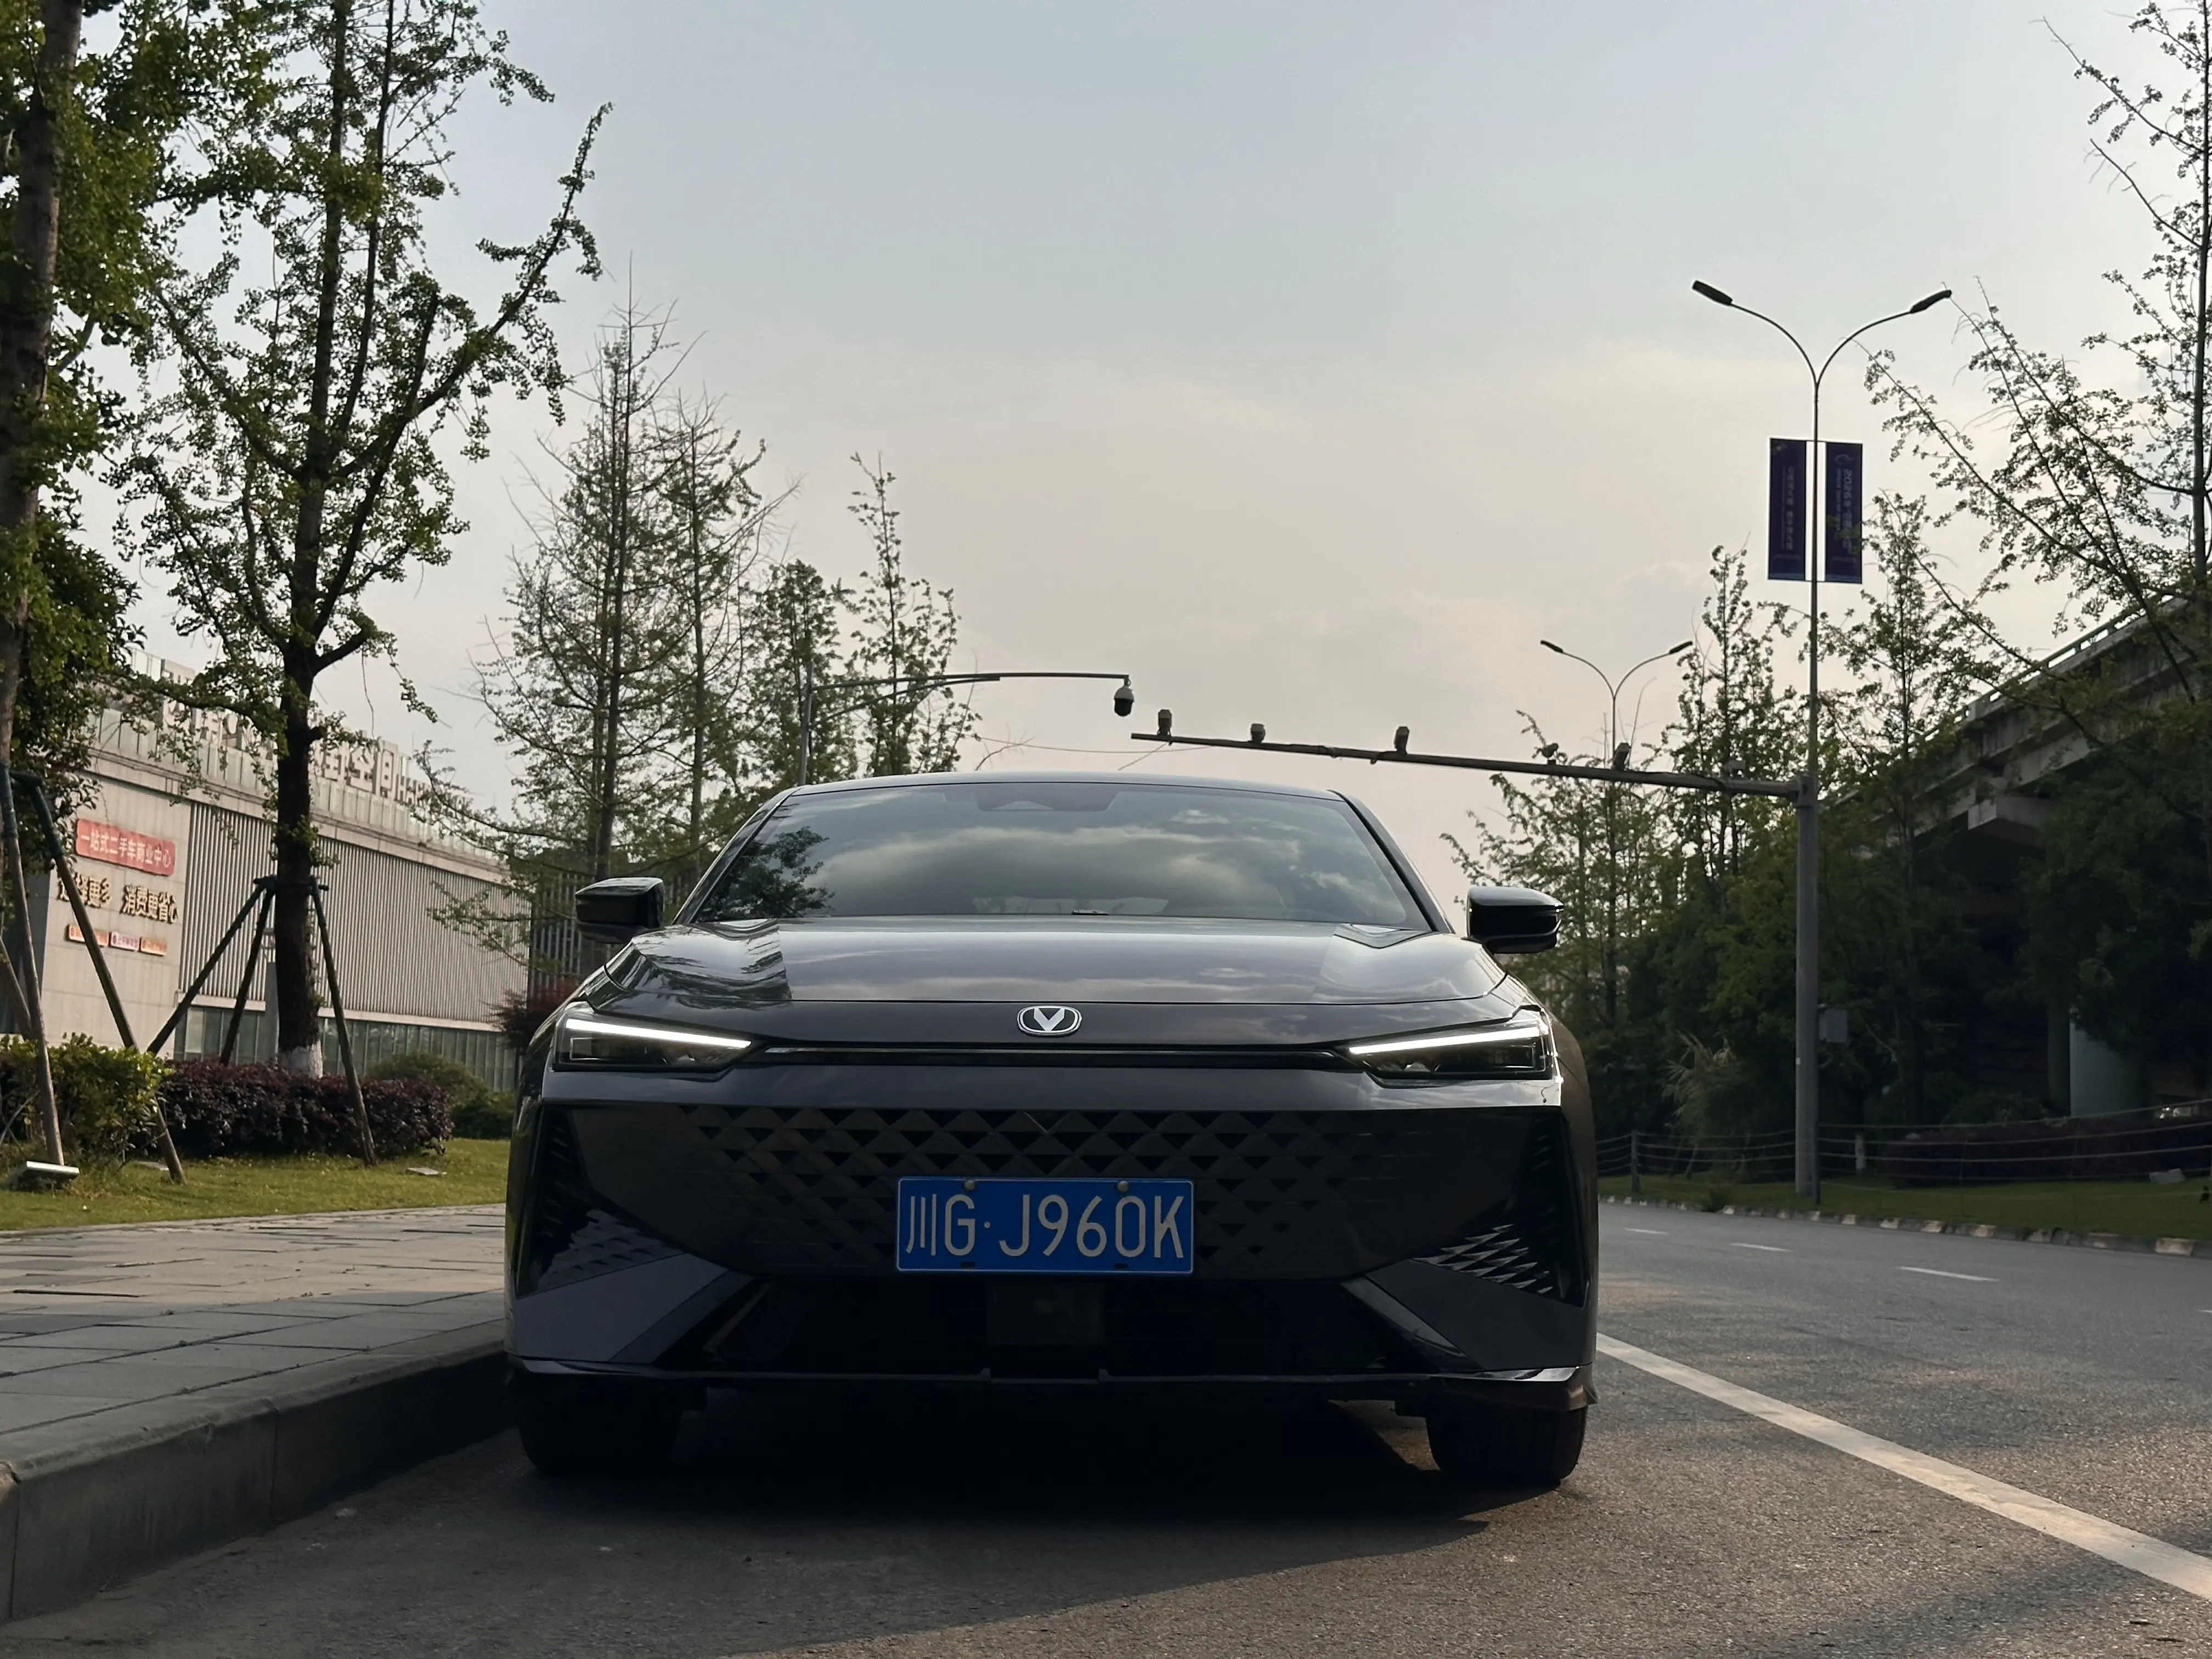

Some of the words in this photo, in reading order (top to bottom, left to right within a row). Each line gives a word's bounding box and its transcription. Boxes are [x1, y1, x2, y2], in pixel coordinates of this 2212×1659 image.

[80, 830, 172, 868] 一站式二手车商业中心
